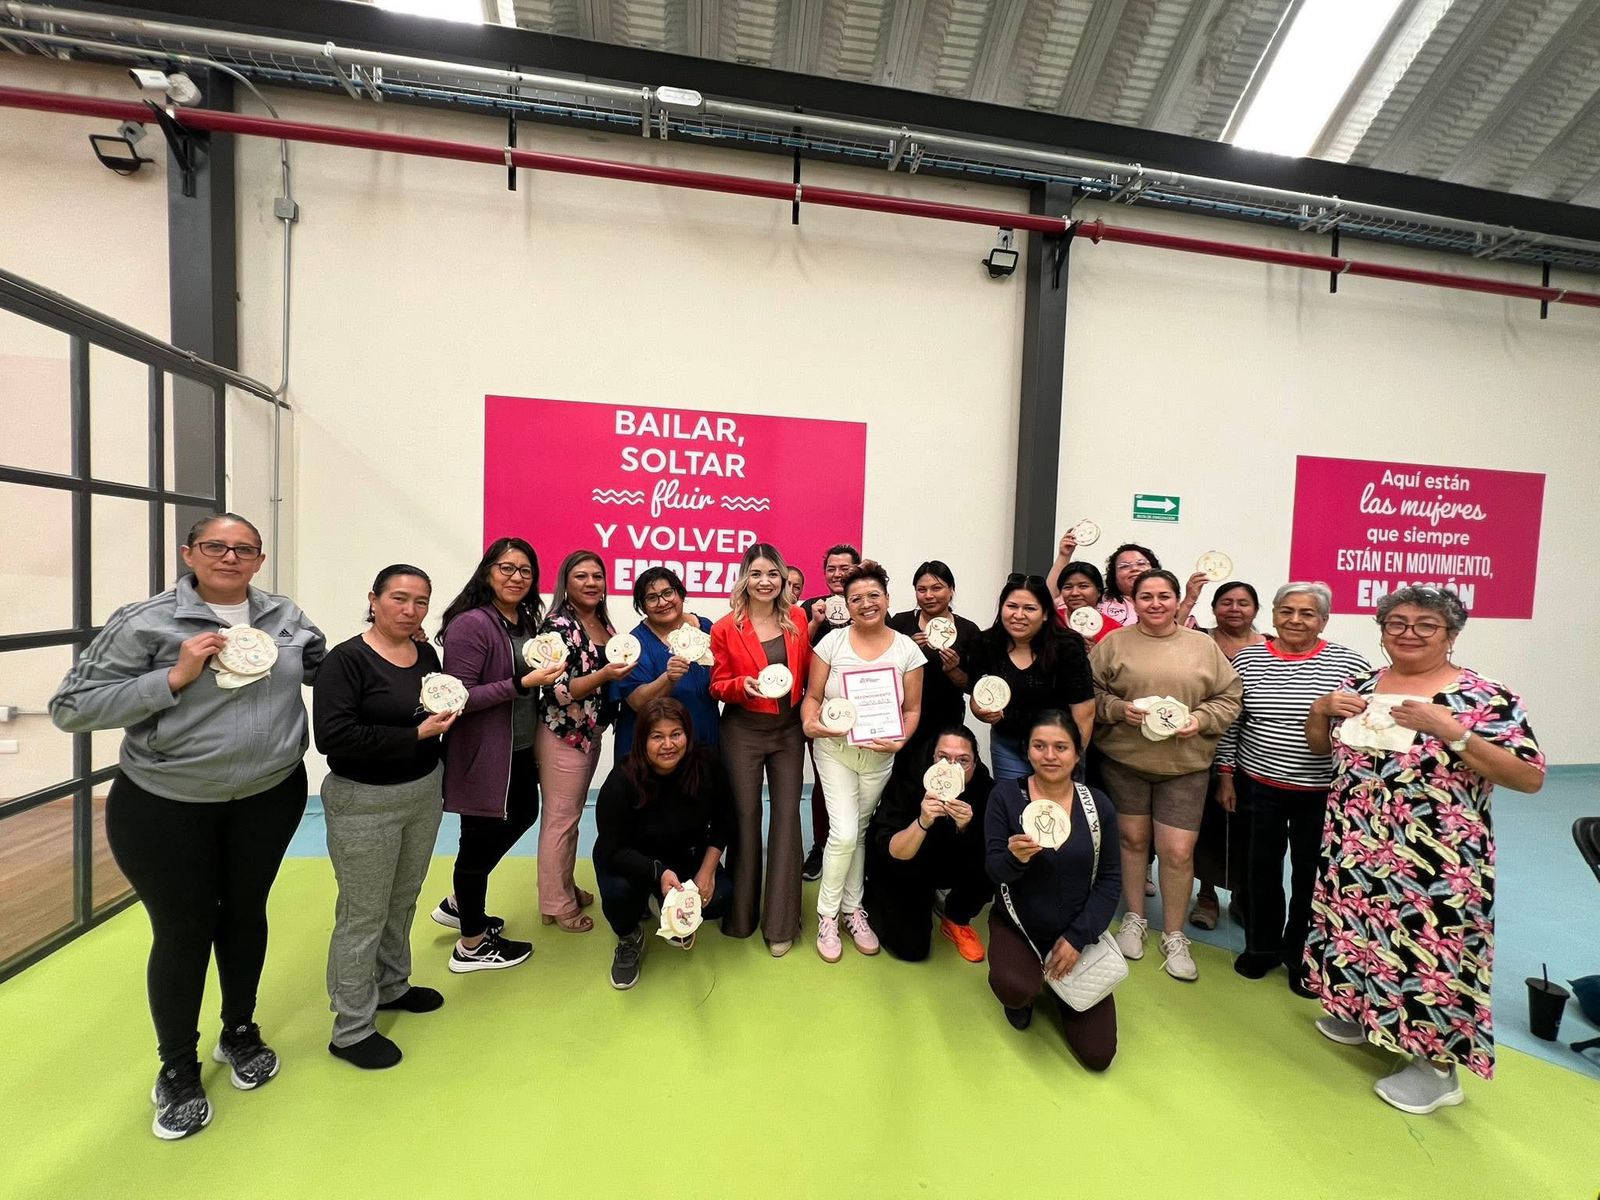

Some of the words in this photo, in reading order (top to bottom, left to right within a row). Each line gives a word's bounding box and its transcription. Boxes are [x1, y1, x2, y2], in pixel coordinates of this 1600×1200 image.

[615, 410, 745, 447] BAILAR,
[620, 446, 746, 478] SOLTAR
[1381, 469, 1422, 490] Aquí
[1424, 474, 1470, 491] están
[651, 479, 715, 518] fluir
[1359, 482, 1397, 515] las
[1400, 494, 1487, 527] mujeres
[594, 523, 618, 548] Y
[627, 525, 758, 554] VOLVER
[1366, 528, 1400, 544] que
[1403, 526, 1470, 547] siempre
[1336, 546, 1382, 571] ESTÁN
[1384, 551, 1403, 573] EN
[1406, 552, 1493, 579] MOVIMIENTO,
